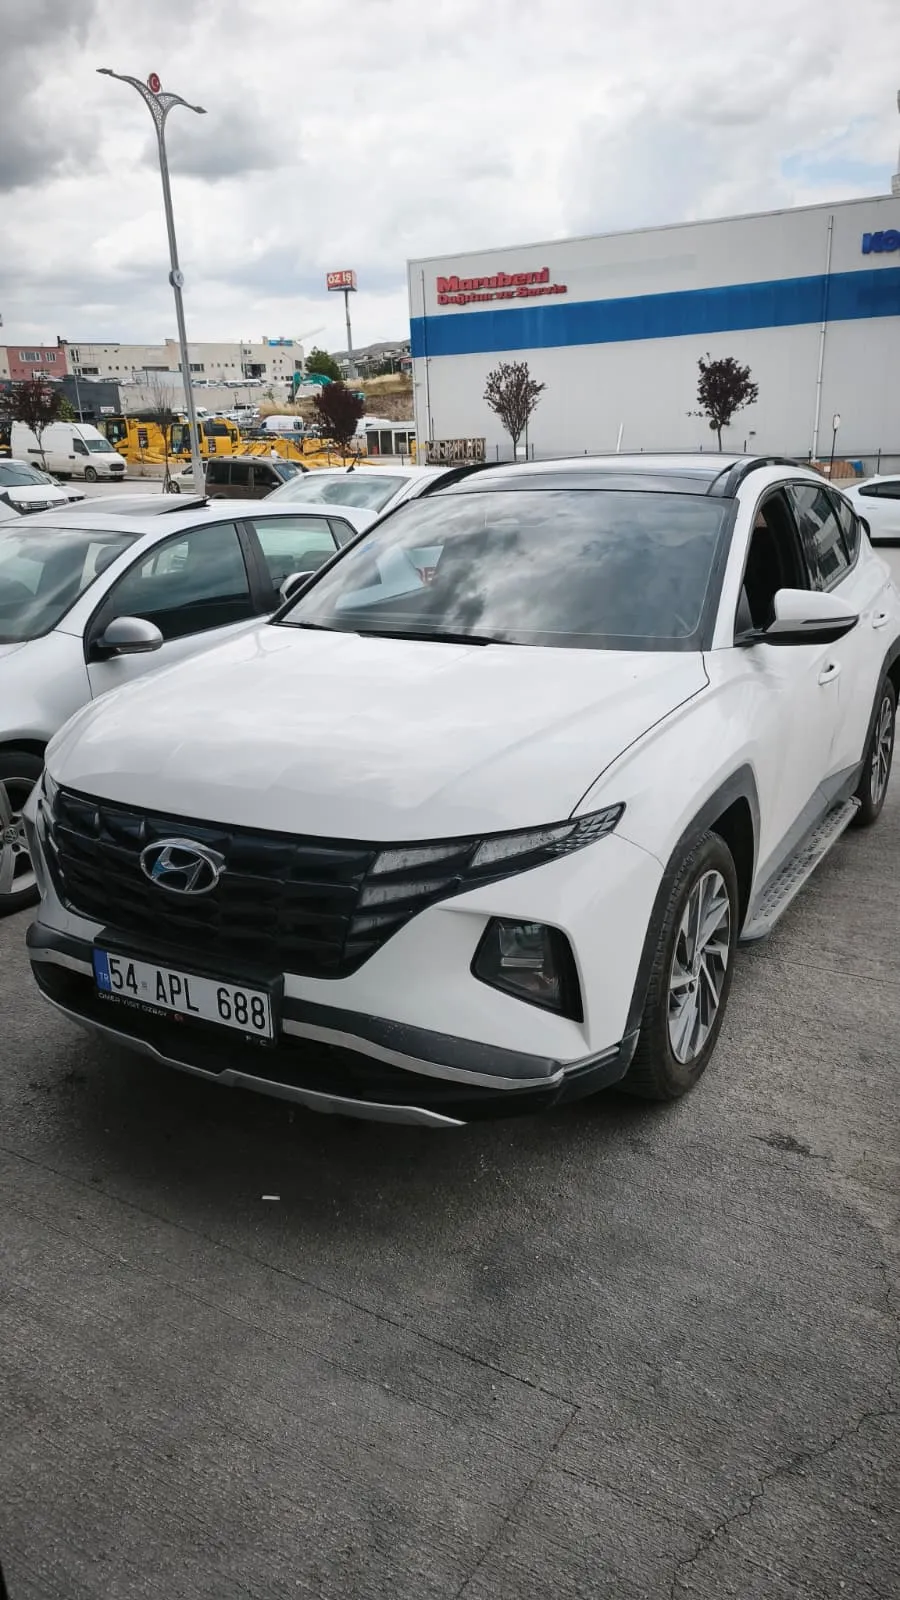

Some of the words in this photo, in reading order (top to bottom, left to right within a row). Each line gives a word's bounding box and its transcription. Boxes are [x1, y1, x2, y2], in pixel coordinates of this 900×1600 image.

[437, 267, 550, 293] Marubeni
[515, 283, 568, 298] Servis
[109, 958, 138, 994] 54
[155, 971, 199, 1012] APL
[216, 987, 266, 1030] 688
